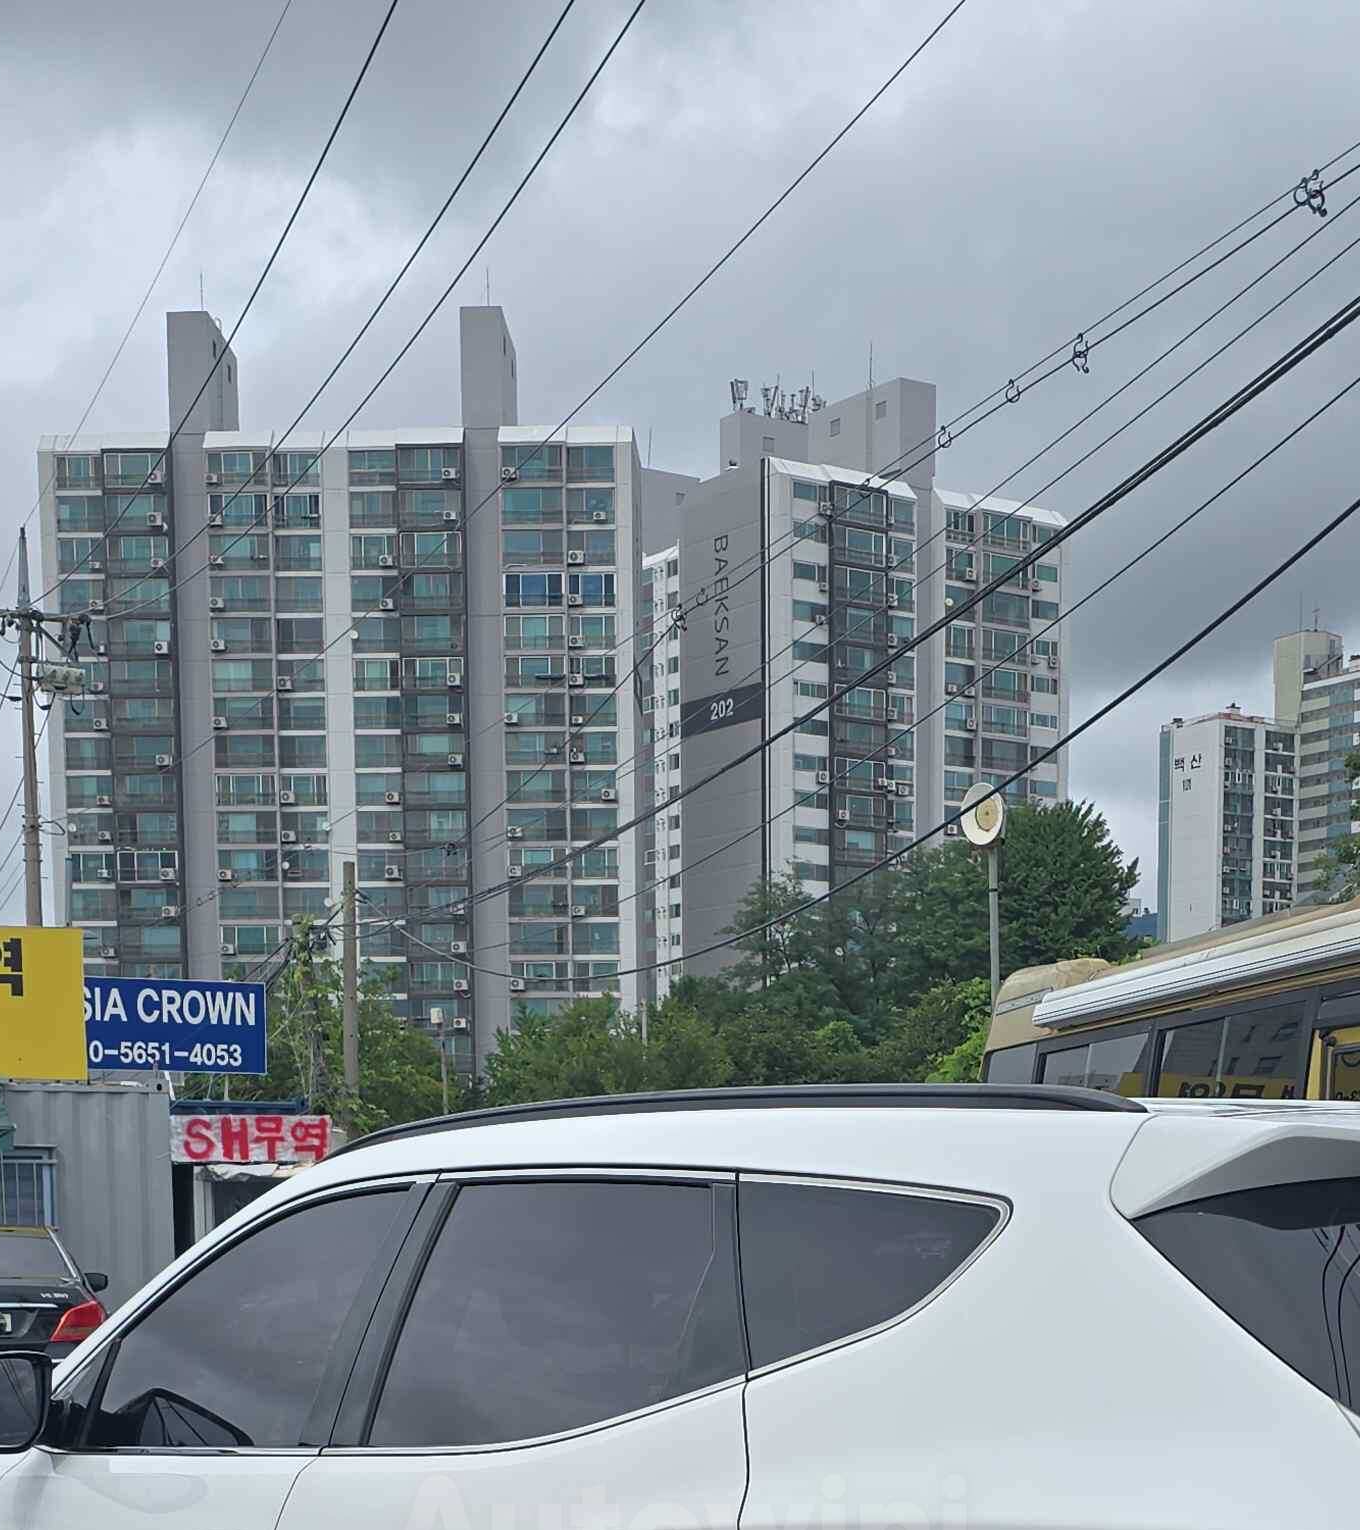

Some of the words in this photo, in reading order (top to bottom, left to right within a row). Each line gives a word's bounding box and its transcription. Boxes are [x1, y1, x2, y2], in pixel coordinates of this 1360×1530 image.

[713, 534, 729, 677] BAEKSAN
[710, 698, 734, 721] 202
[136, 988, 256, 1026] CROWN
